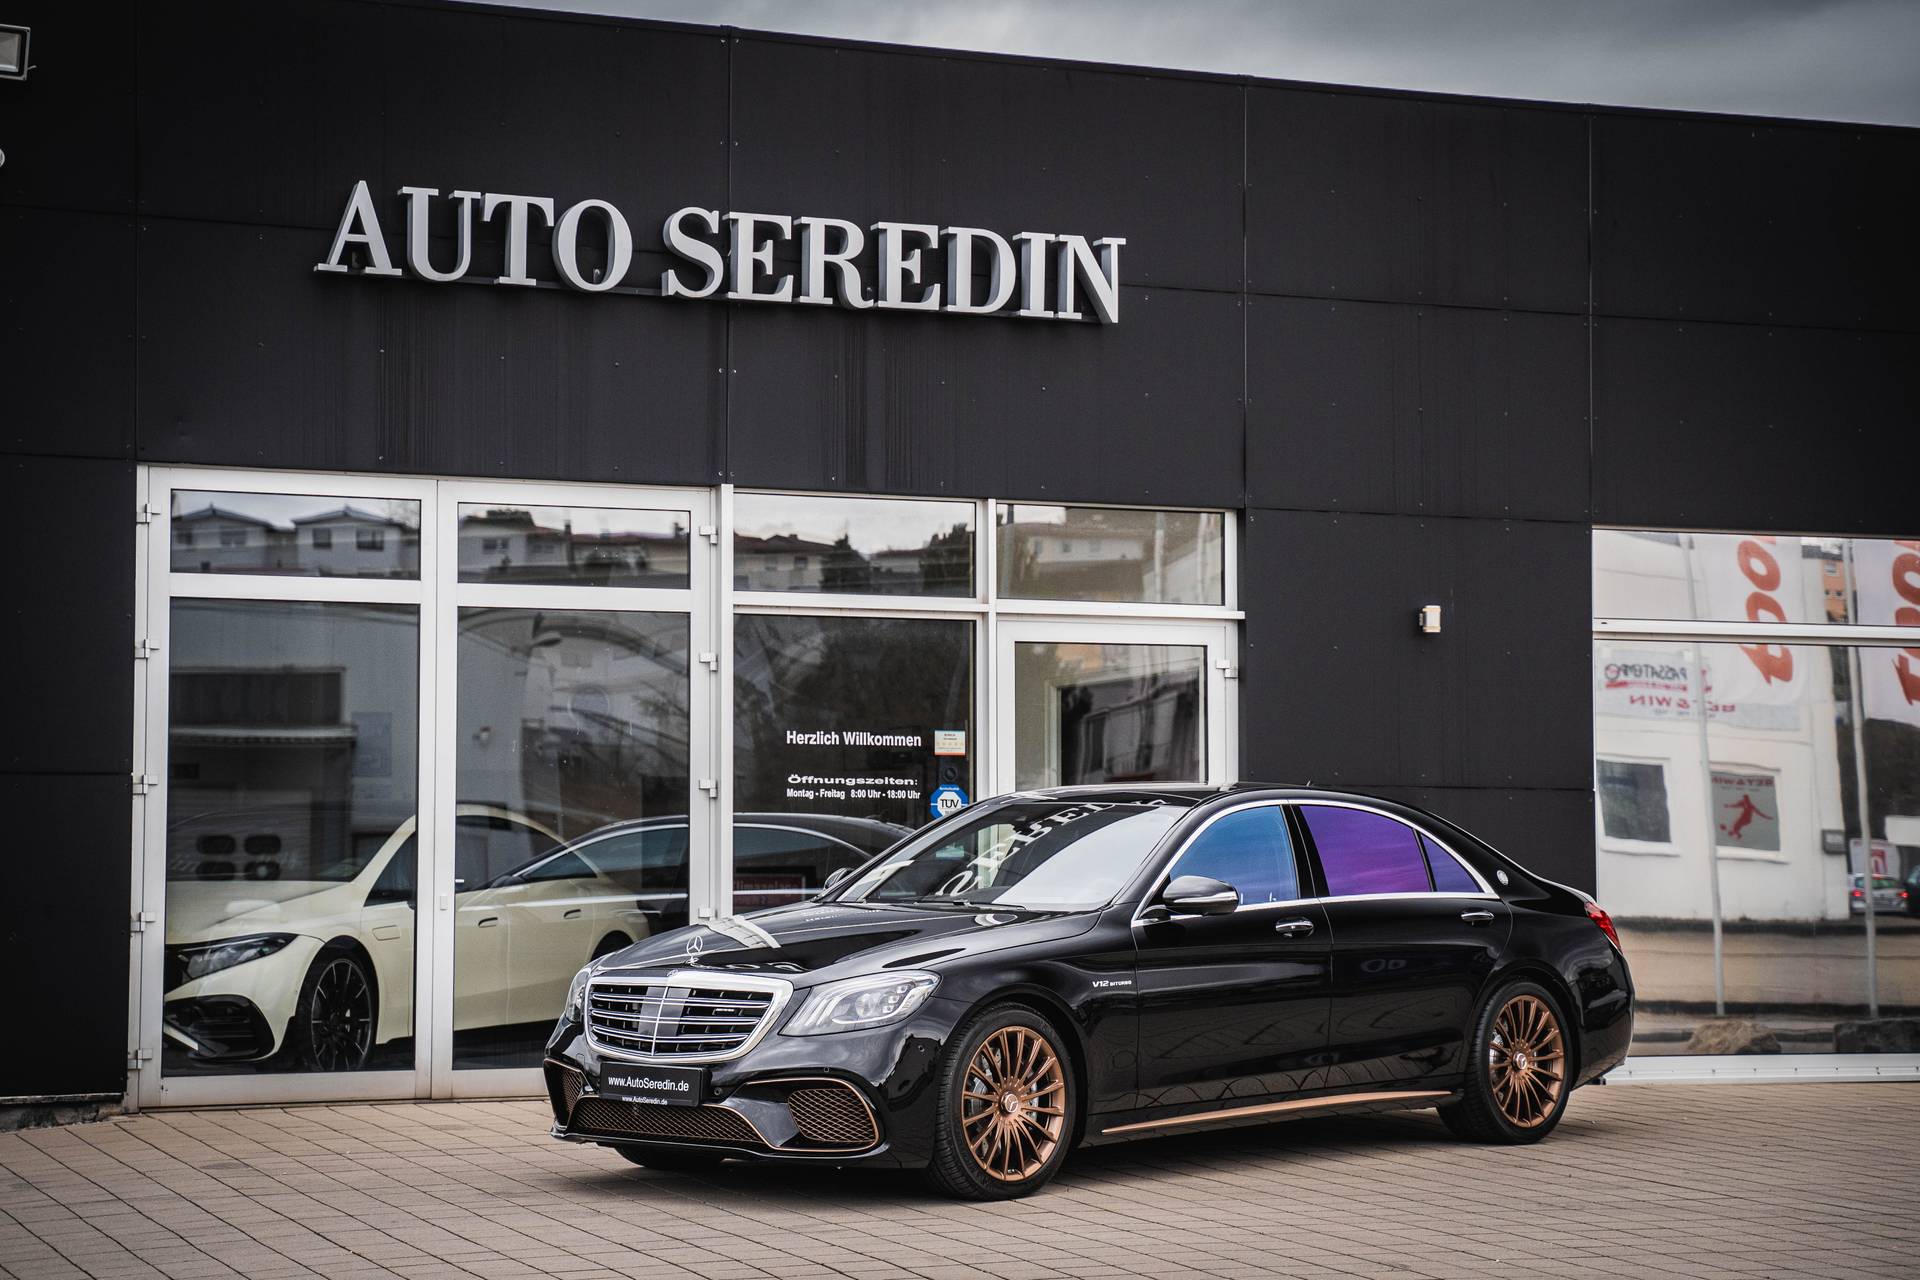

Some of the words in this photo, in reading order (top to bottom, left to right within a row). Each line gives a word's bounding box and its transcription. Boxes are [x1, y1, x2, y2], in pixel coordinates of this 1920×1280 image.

[314, 180, 633, 292] AUTO
[662, 206, 1127, 324] SEREDIN
[786, 730, 840, 746] Herzlich
[842, 731, 922, 747] Willkommen
[787, 773, 919, 787] Öffnungszeiten:
[786, 788, 814, 800] Montag
[820, 788, 846, 800] Freitag
[850, 788, 867, 799] 8:00
[867, 789, 881, 799] Uhr
[886, 789, 907, 800] 18:00
[907, 790, 921, 800] Uhr
[1092, 980, 1110, 988] V12
[607, 1075, 690, 1092] www.AutoSeredin.de
[621, 1095, 669, 1106] www.AutoSeredin.de
